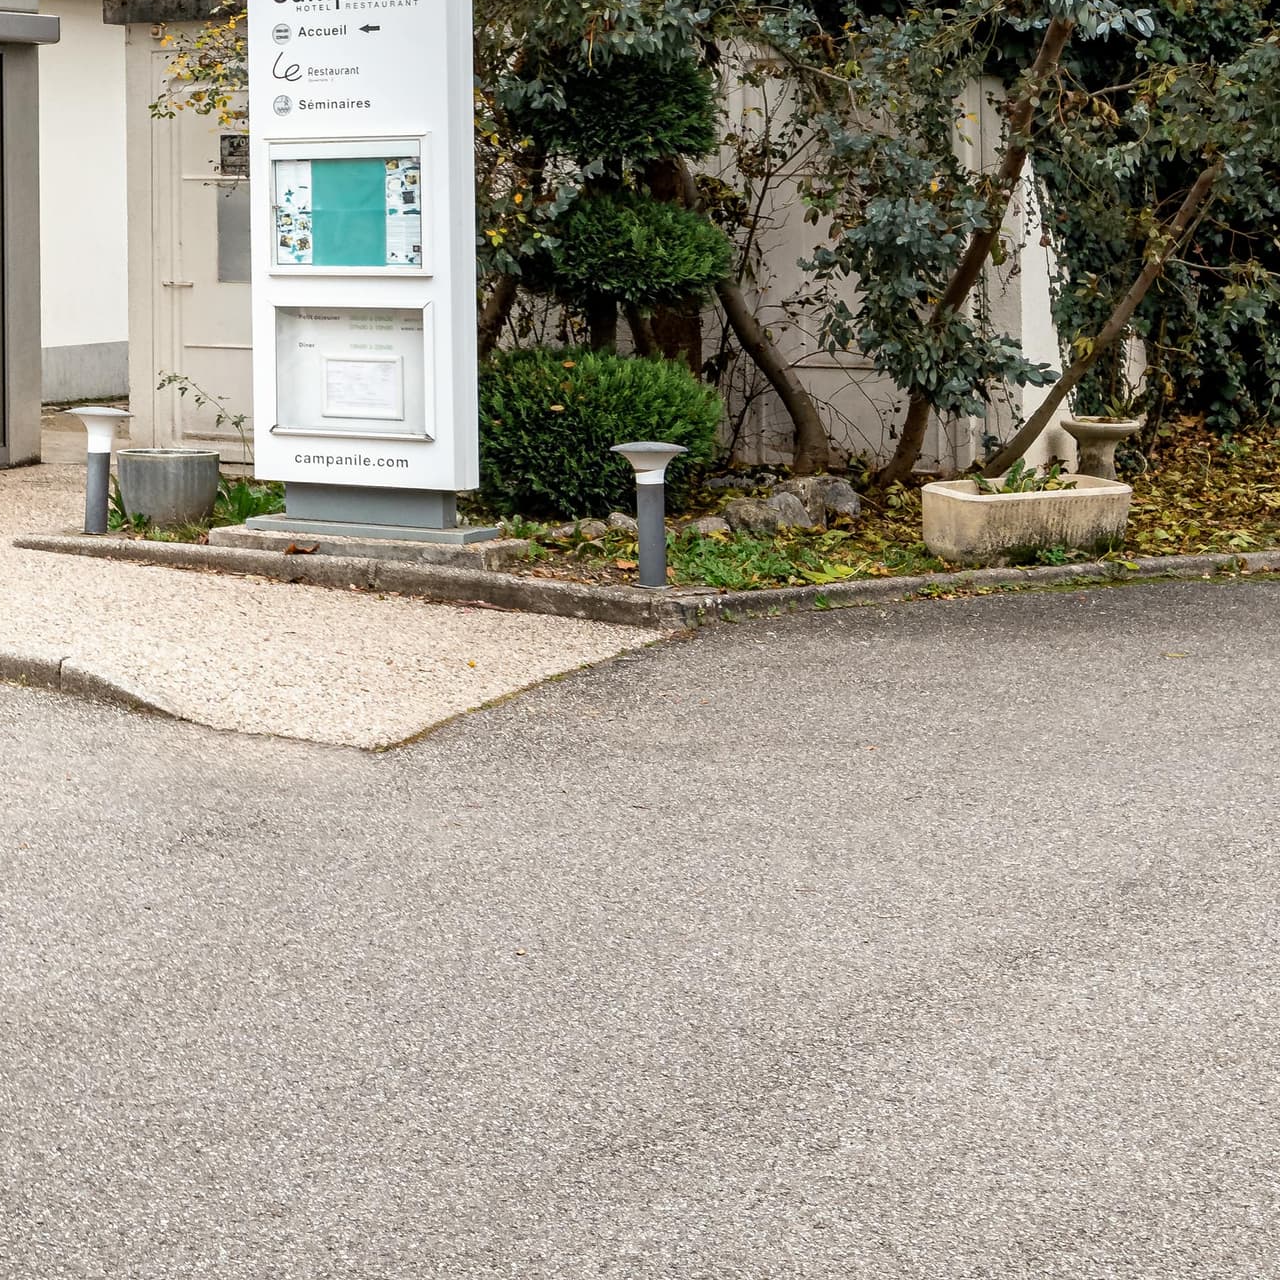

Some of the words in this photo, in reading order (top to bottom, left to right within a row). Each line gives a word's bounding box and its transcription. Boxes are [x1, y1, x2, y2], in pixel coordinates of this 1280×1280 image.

[296, 4, 331, 12] HOTEL
[345, 0, 418, 9] RESTAURANT
[298, 25, 347, 37] Accueil
[273, 52, 302, 81] Le
[307, 66, 359, 76] Restaurant
[298, 98, 371, 110] Séminaires
[294, 454, 409, 468] campanile.com
